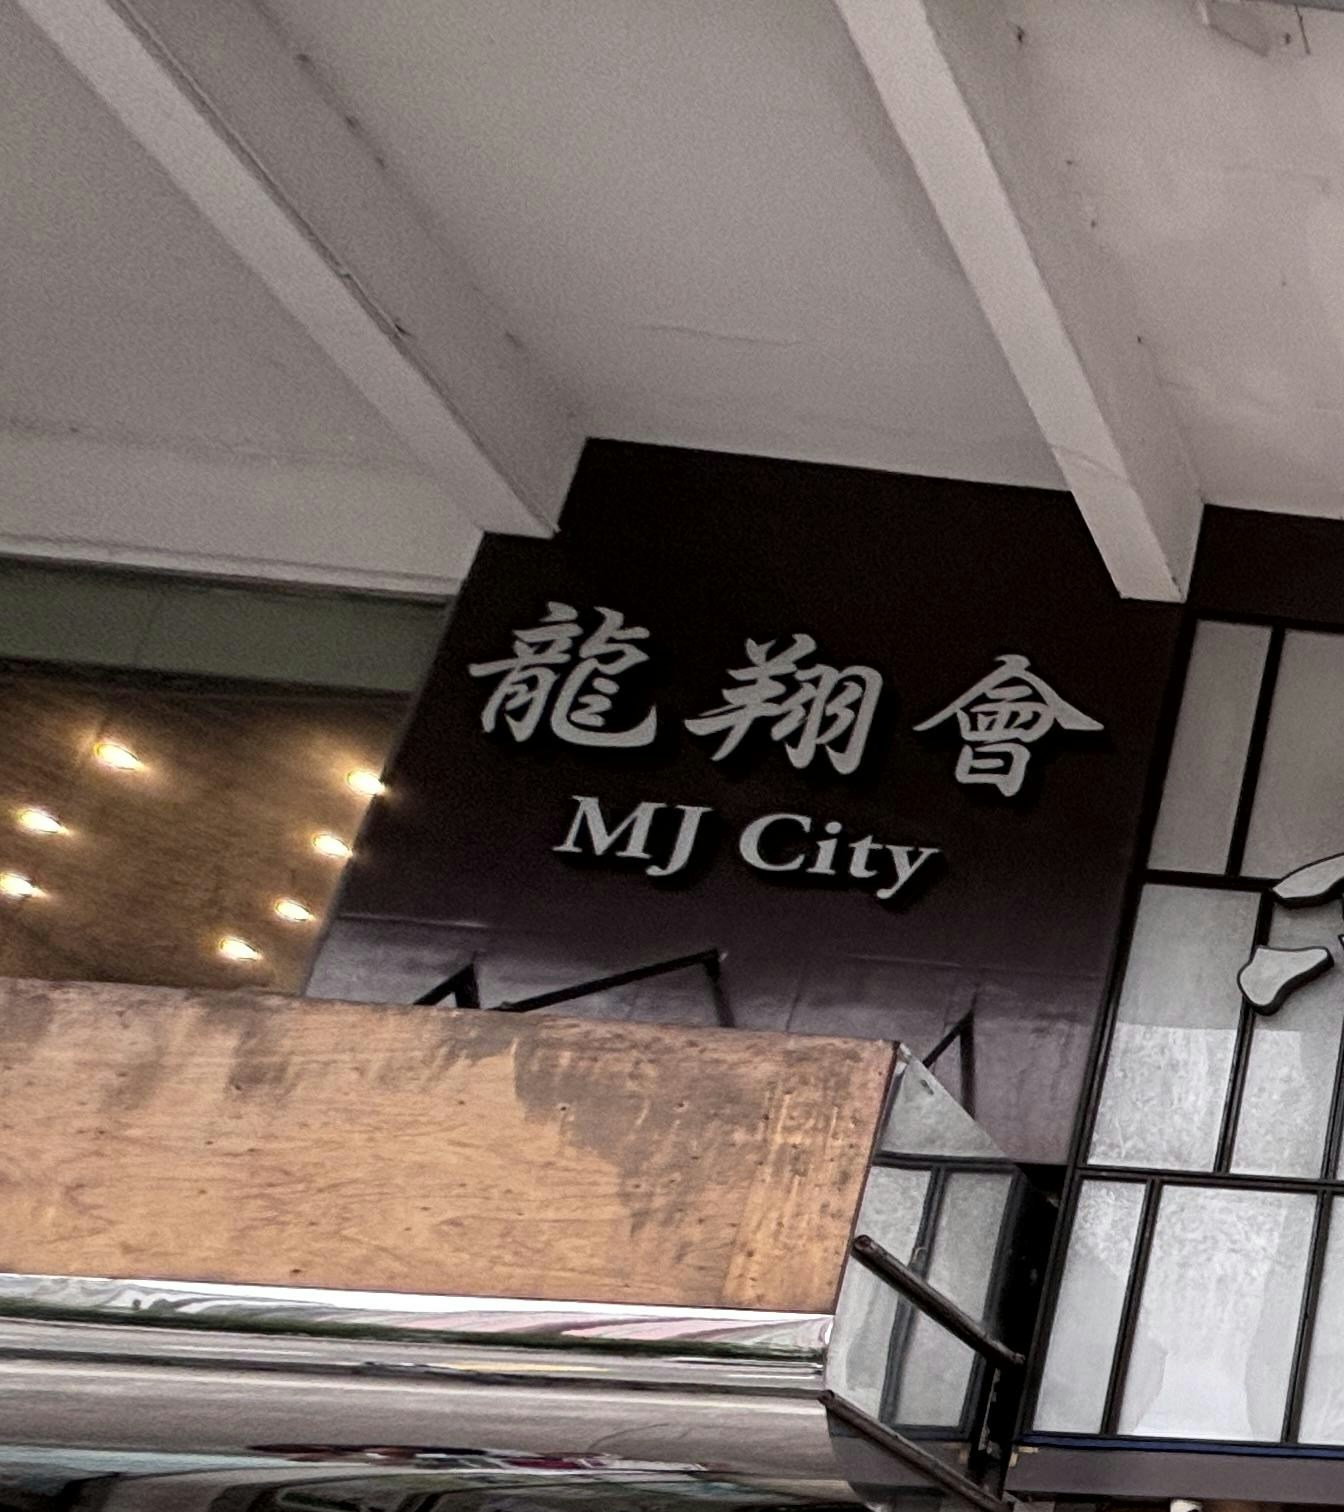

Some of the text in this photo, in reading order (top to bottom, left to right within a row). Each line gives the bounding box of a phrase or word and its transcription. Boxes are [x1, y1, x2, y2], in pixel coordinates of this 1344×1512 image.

[467, 602, 1105, 797] 龍翔會
[553, 796, 941, 900] MJ City
